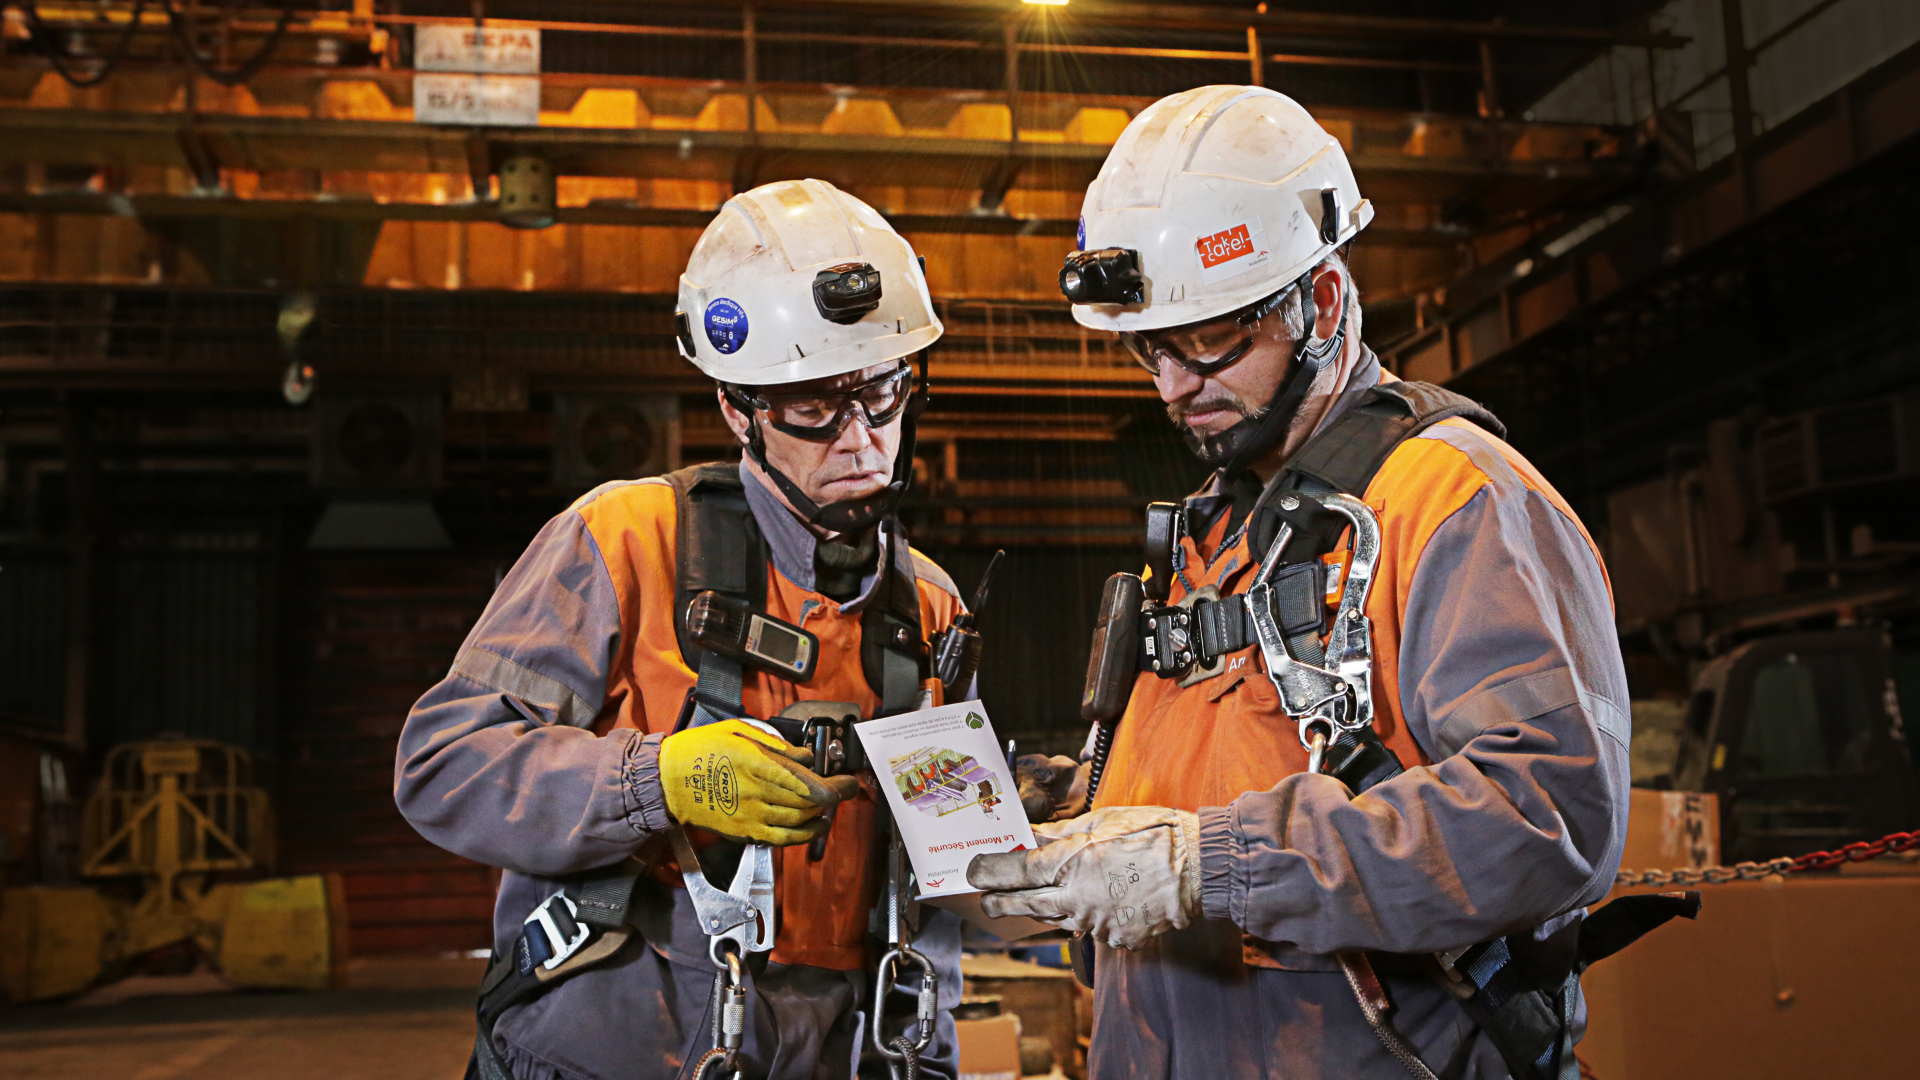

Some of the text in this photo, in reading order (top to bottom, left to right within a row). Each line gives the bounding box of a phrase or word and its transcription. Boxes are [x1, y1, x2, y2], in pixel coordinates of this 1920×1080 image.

[928, 834, 1016, 854] Le Moment Sécurité
